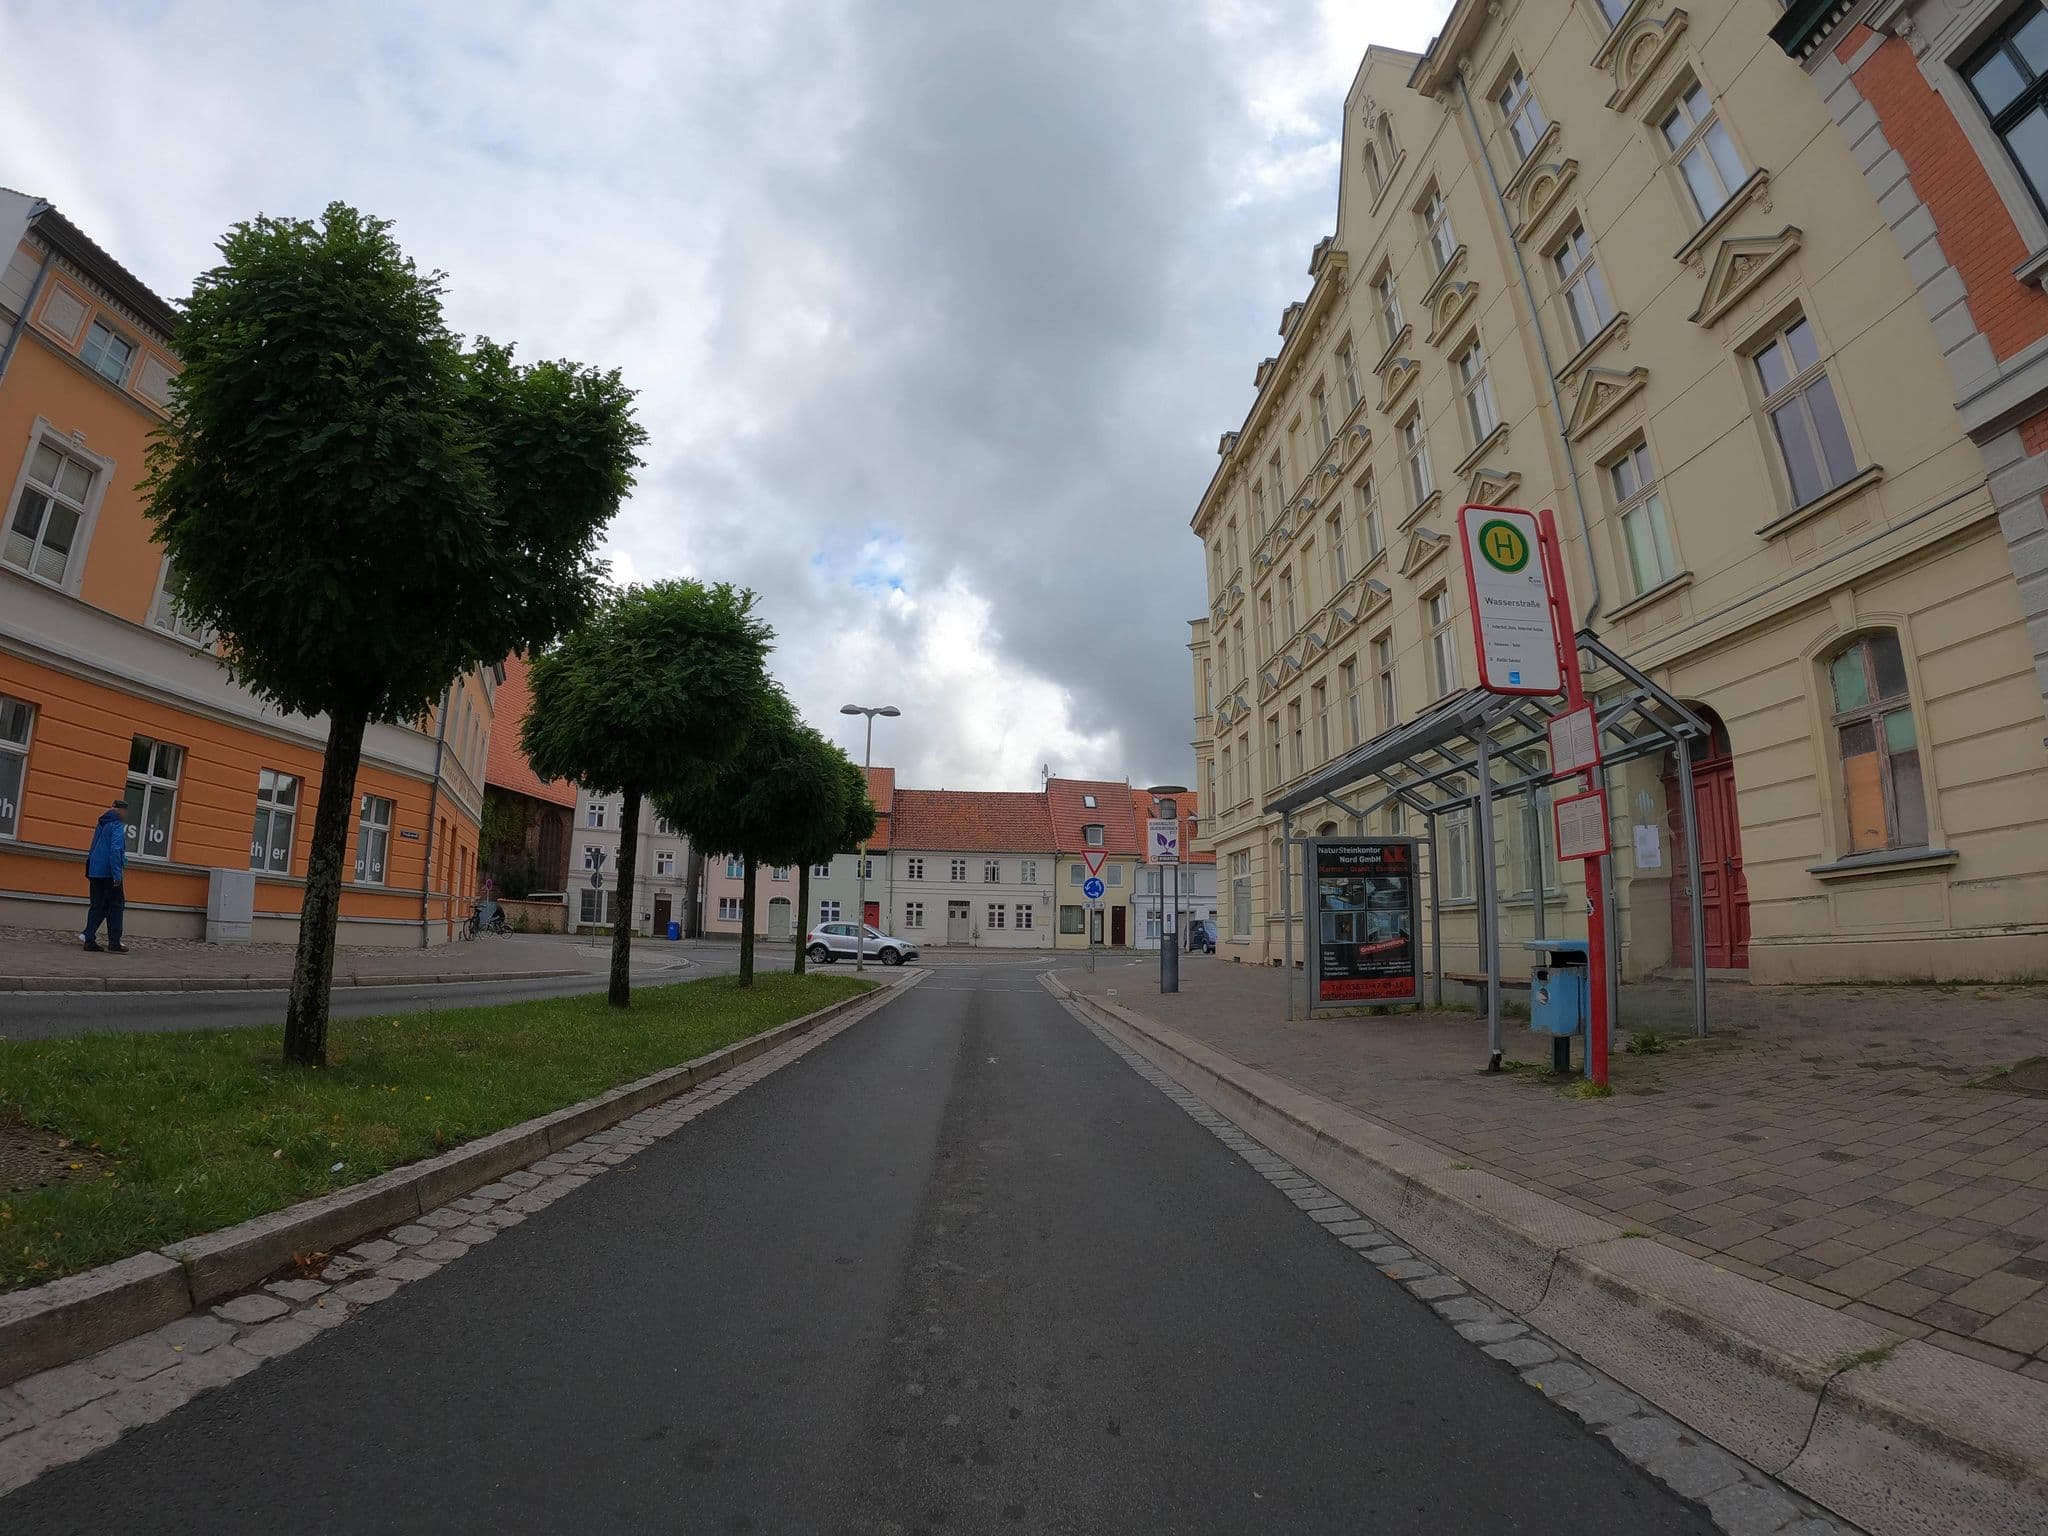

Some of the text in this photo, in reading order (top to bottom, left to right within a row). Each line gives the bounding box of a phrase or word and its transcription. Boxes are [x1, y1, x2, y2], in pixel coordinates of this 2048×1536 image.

[1494, 533, 1514, 559] H
[1484, 596, 1541, 609] Wasserstraße
[0, 797, 14, 819] h
[1318, 846, 1381, 854] NaturSteinkontor
[1340, 855, 1381, 863] Nord GmbH
